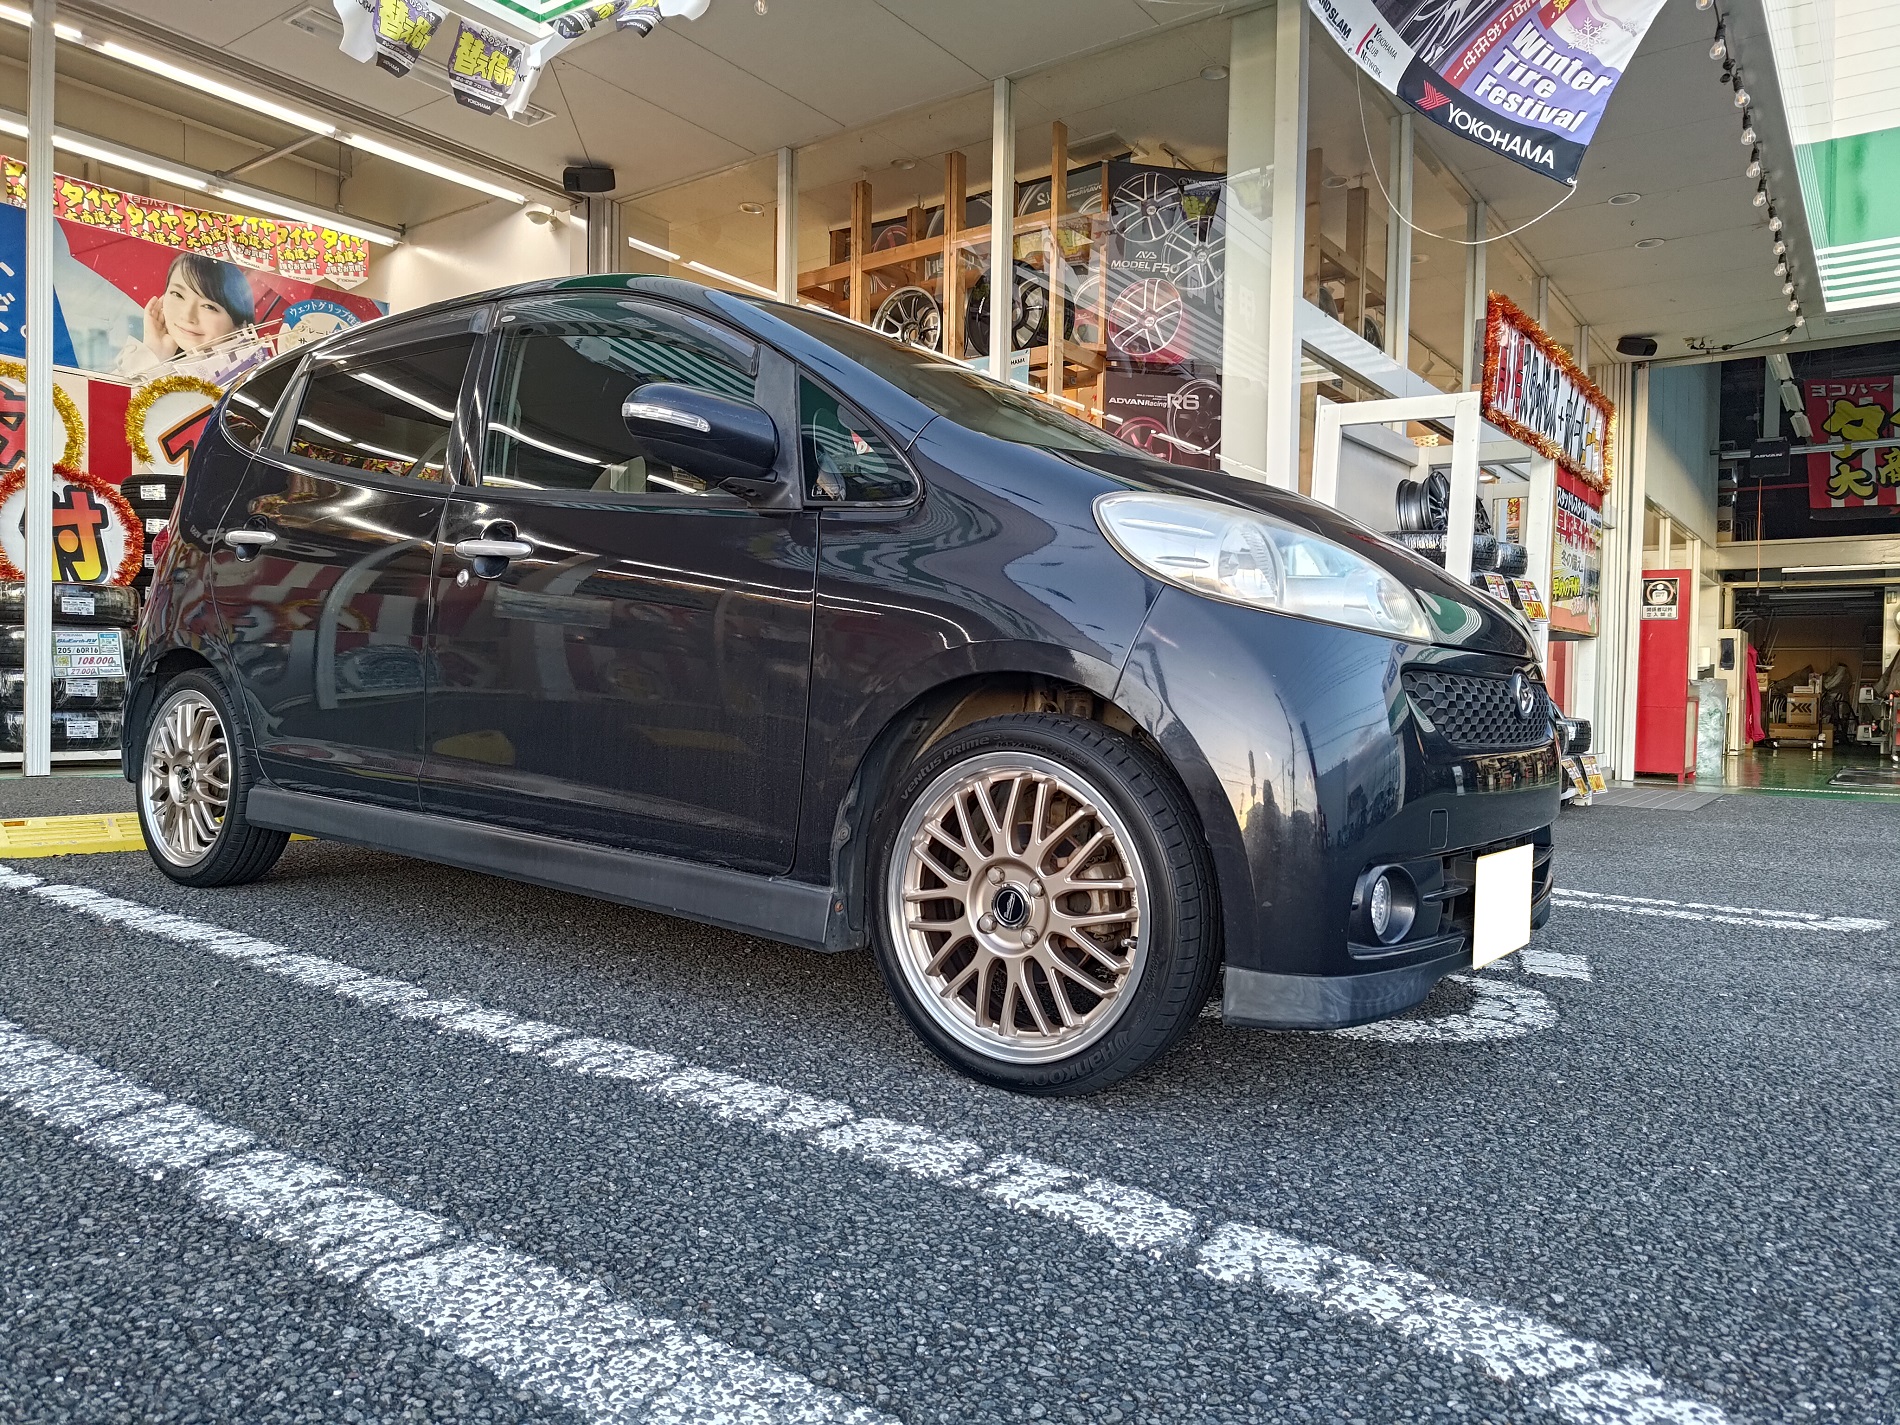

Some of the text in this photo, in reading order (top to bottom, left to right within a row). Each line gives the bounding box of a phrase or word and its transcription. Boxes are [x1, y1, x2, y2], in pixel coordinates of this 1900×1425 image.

[1329, 9, 1352, 39] SLAM
[1493, 46, 1557, 98] Tire
[1512, 19, 1613, 96] Winter
[1474, 72, 1588, 133] Festival
[1447, 103, 1555, 169] YOKOHAMA
[60, 181, 121, 208] タイヤ
[126, 203, 181, 231] タイヤ
[1111, 260, 1151, 269] MODEL
[1152, 262, 1181, 274] F50
[1167, 392, 1200, 410] R6
[1810, 383, 1890, 397] ヨコハマ
[1822, 398, 1900, 460] タ
